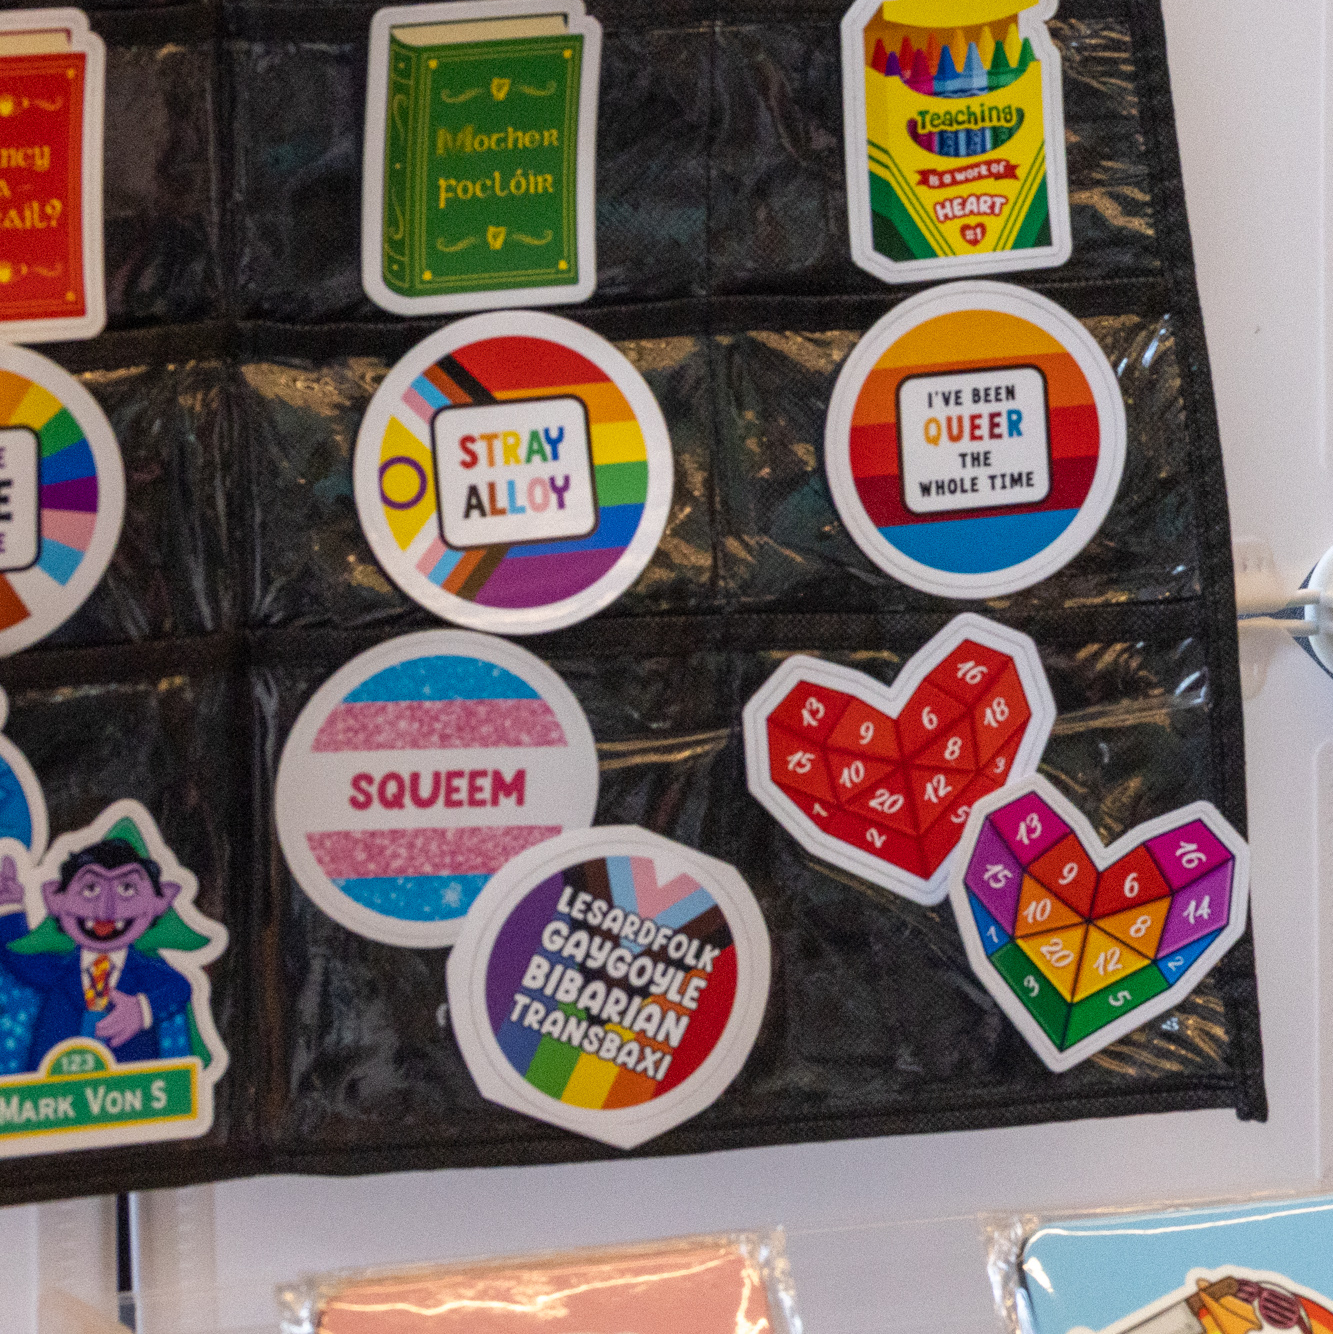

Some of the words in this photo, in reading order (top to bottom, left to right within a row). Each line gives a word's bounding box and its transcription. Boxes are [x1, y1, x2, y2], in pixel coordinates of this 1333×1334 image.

[917, 103, 1013, 129] Teaching
[954, 165, 989, 181] work
[935, 195, 1007, 222] HEART
[928, 389, 963, 409] I'VE
[971, 383, 1016, 404] BEEN
[923, 408, 1024, 445] QUEER
[458, 425, 564, 470] STRAY
[959, 450, 992, 468] THE
[463, 473, 571, 519] ALLOY
[919, 473, 980, 498] WHOLE
[987, 469, 1036, 492] TIME
[956, 660, 988, 685] 16
[801, 697, 825, 727] 13
[921, 706, 939, 730] 6
[983, 697, 1010, 728] 18
[859, 721, 875, 745] 9
[944, 736, 963, 760] 8
[787, 750, 816, 774] 15
[839, 760, 866, 788] 10
[349, 768, 527, 812] SQUEEM
[869, 788, 905, 814] 20
[924, 774, 952, 803] 12
[866, 827, 887, 848] 2
[1015, 812, 1043, 845] 13
[1175, 841, 1207, 869] 16
[983, 864, 1013, 889] 15
[1058, 862, 1078, 885] 9
[1123, 872, 1140, 898] 6
[1023, 898, 1052, 923] 10
[1183, 895, 1212, 924] 14
[557, 886, 721, 973] LESARDFOLK
[1129, 915, 1151, 938] 8
[541, 920, 707, 1010] GAYGOYLE
[1040, 938, 1074, 967] 20
[1093, 947, 1122, 975] 12
[1023, 975, 1040, 998] 3
[1109, 989, 1132, 1007] 5
[521, 954, 690, 1048] BIBARIAN
[510, 993, 673, 1081] TRANSBAXI
[61, 1053, 95, 1072] 123
[84, 1084, 143, 1115] VON
[150, 1078, 168, 1109] S
